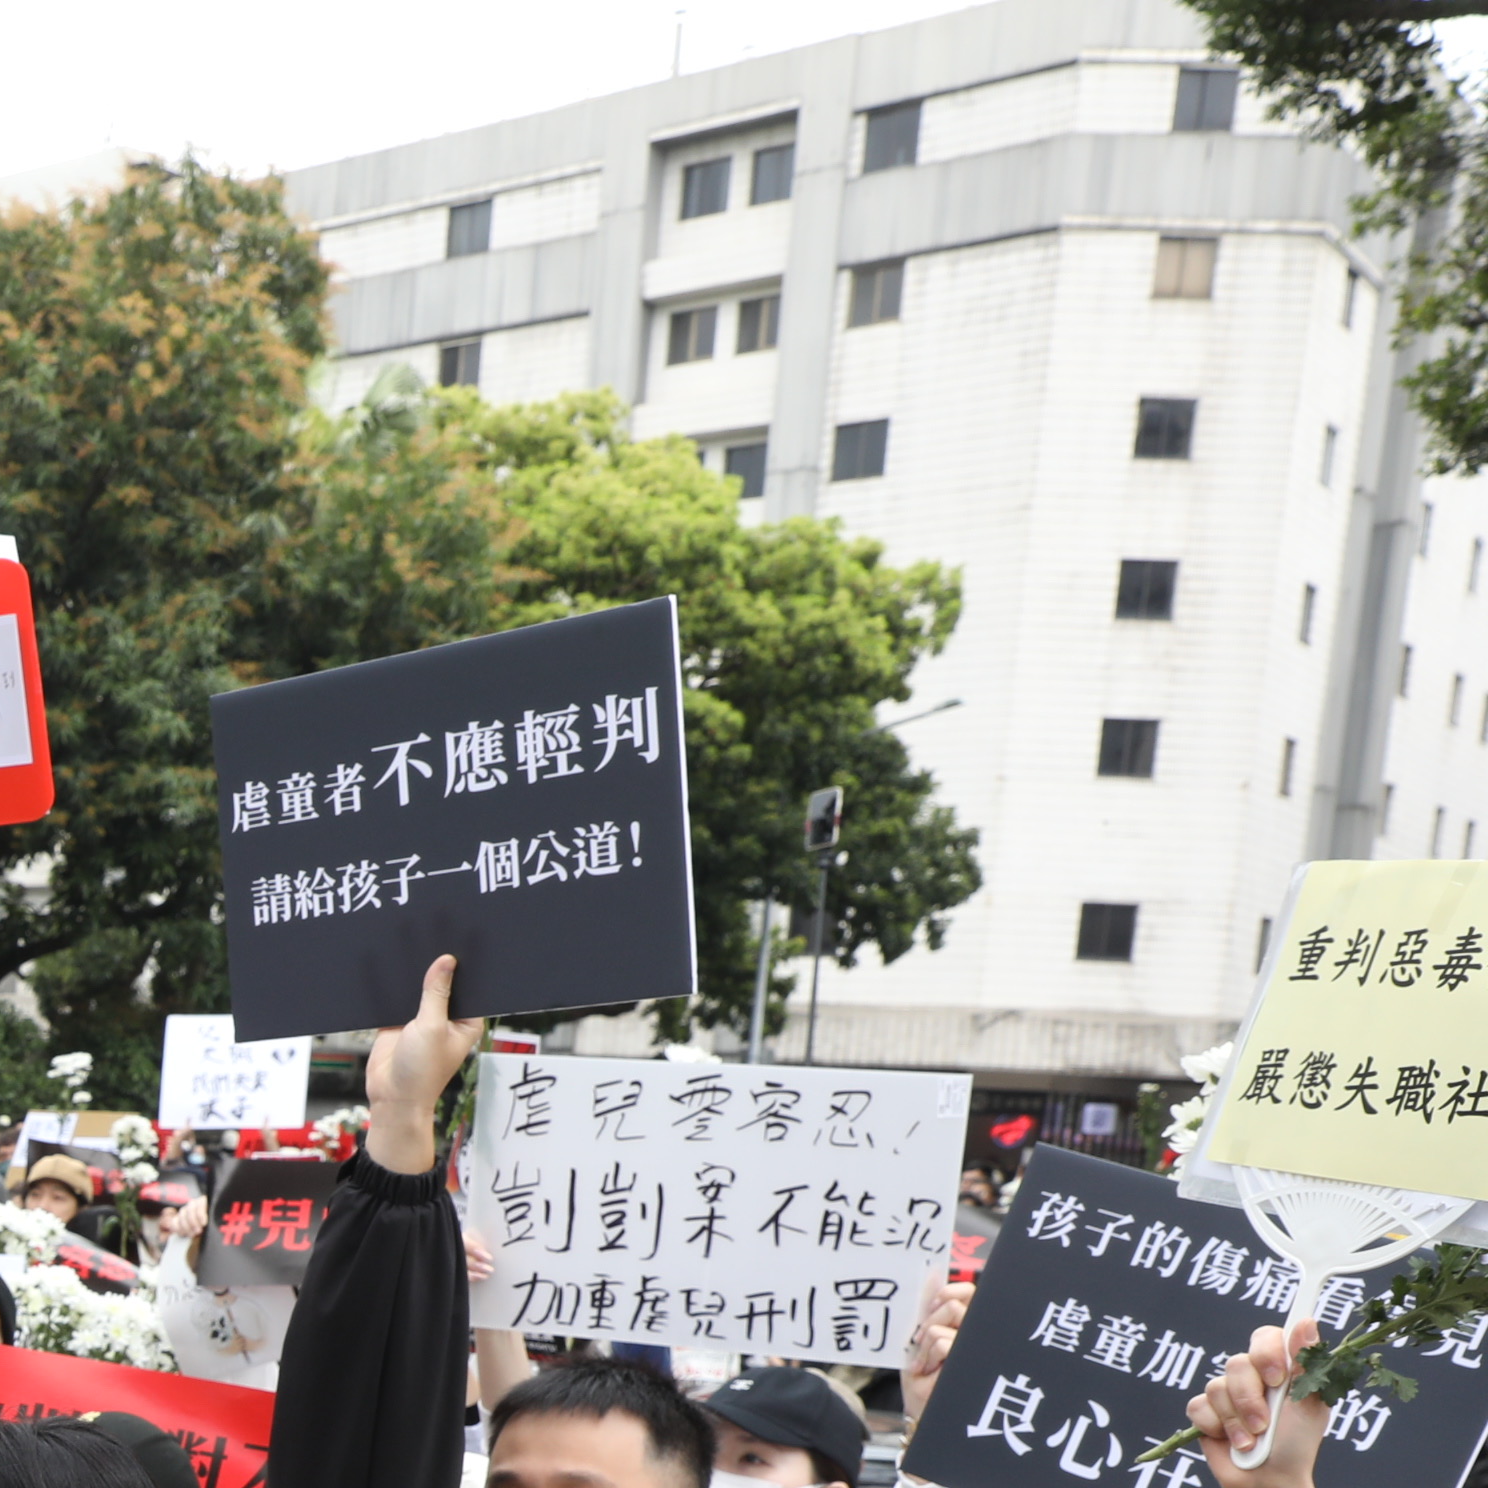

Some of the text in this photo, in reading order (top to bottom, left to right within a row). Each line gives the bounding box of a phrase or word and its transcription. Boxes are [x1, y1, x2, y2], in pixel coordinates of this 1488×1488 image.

[231, 686, 661, 834] 虐童者不應輕判
[250, 820, 645, 927] 請給孩子一個公道!
[1288, 925, 1488, 992] 重判惡毒
[500, 1062, 921, 1156] 虐兒零容忍!
[1238, 1048, 1488, 1125] 嚴懲失職社
[219, 1196, 328, 1252] #兒
[490, 1161, 947, 1265] 剴剴案不能沉!
